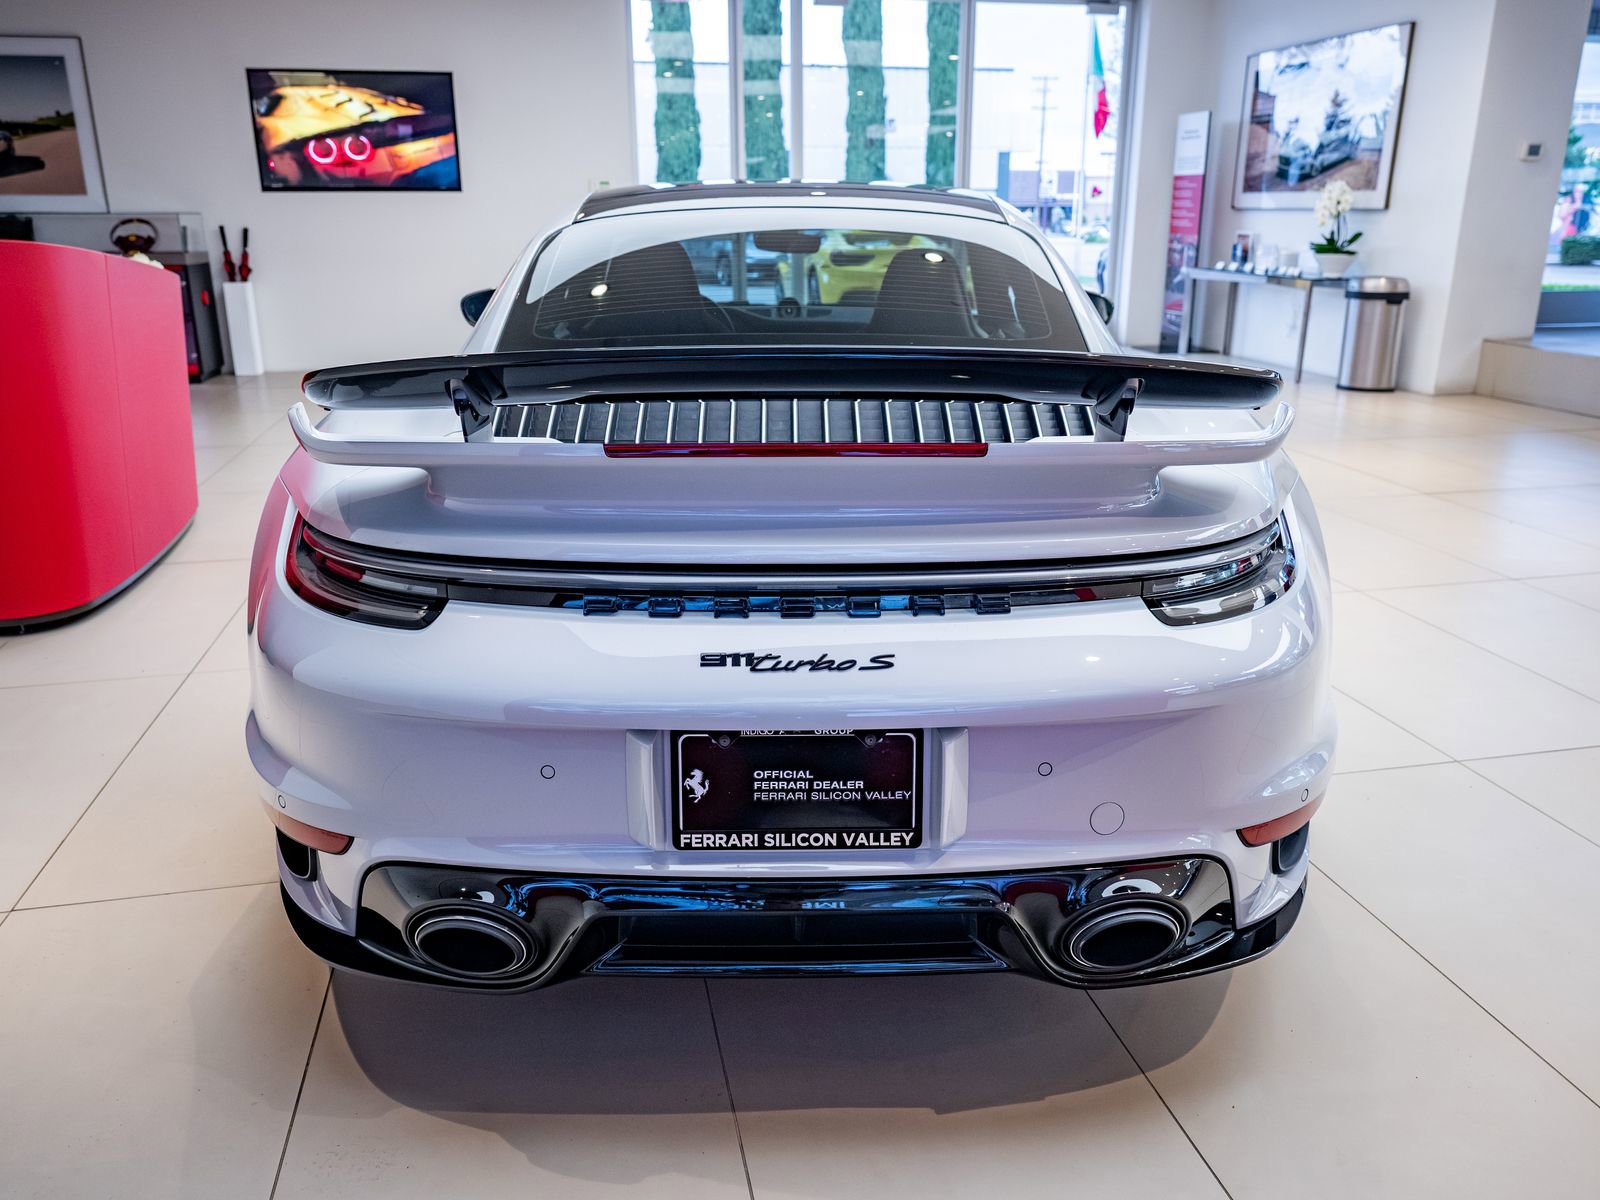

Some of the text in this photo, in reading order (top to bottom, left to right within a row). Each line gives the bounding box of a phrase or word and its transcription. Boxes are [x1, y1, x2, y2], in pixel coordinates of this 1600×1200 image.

[750, 653, 857, 672] turbo
[858, 654, 896, 670] S
[753, 770, 814, 779] OFFICIAL
[753, 780, 864, 790] FERRARI DEALER
[753, 790, 912, 801] FERRARI SILICON VALLEY
[680, 832, 914, 848] FERRARI SILICON VALLEY
